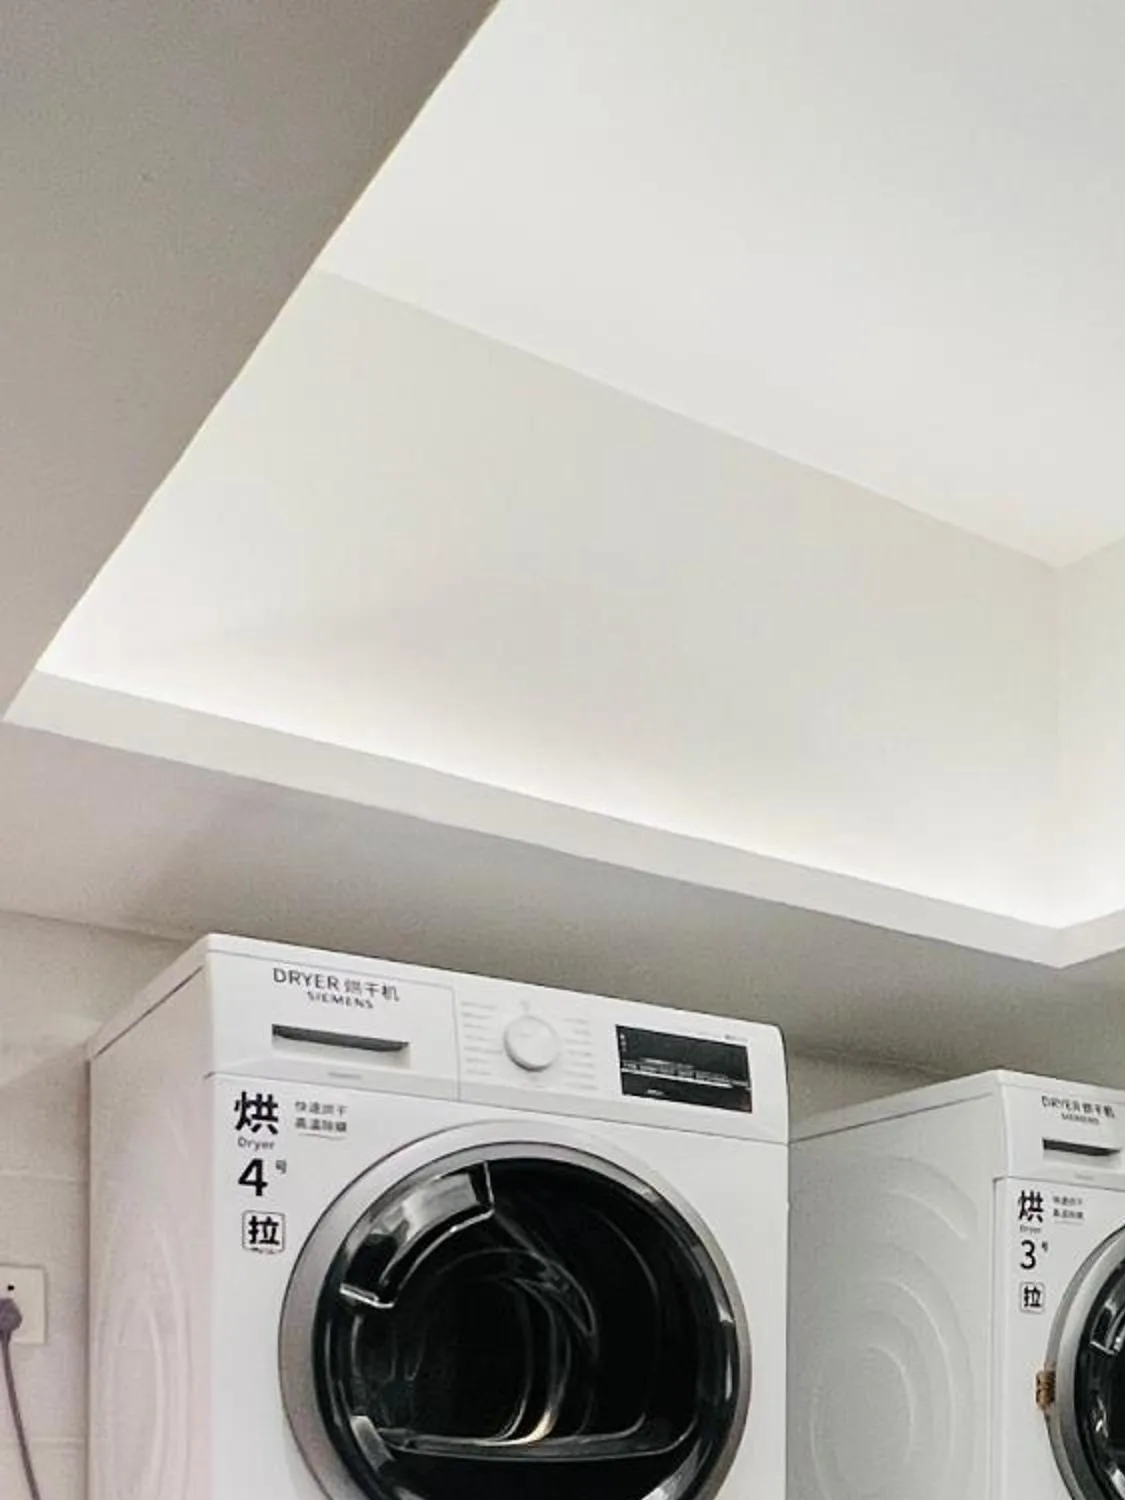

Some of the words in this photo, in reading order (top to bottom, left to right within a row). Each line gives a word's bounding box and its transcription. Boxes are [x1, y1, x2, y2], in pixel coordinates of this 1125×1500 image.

[273, 967, 340, 991] DRYER
[344, 979, 400, 1001] 烘干机
[306, 991, 374, 1009] SIEMENS
[233, 1091, 279, 1135] 烘
[237, 1136, 275, 1151] Dryer
[1017, 1190, 1043, 1223] 烘
[248, 1215, 280, 1246] 拉
[1023, 1286, 1042, 1309] 拉
